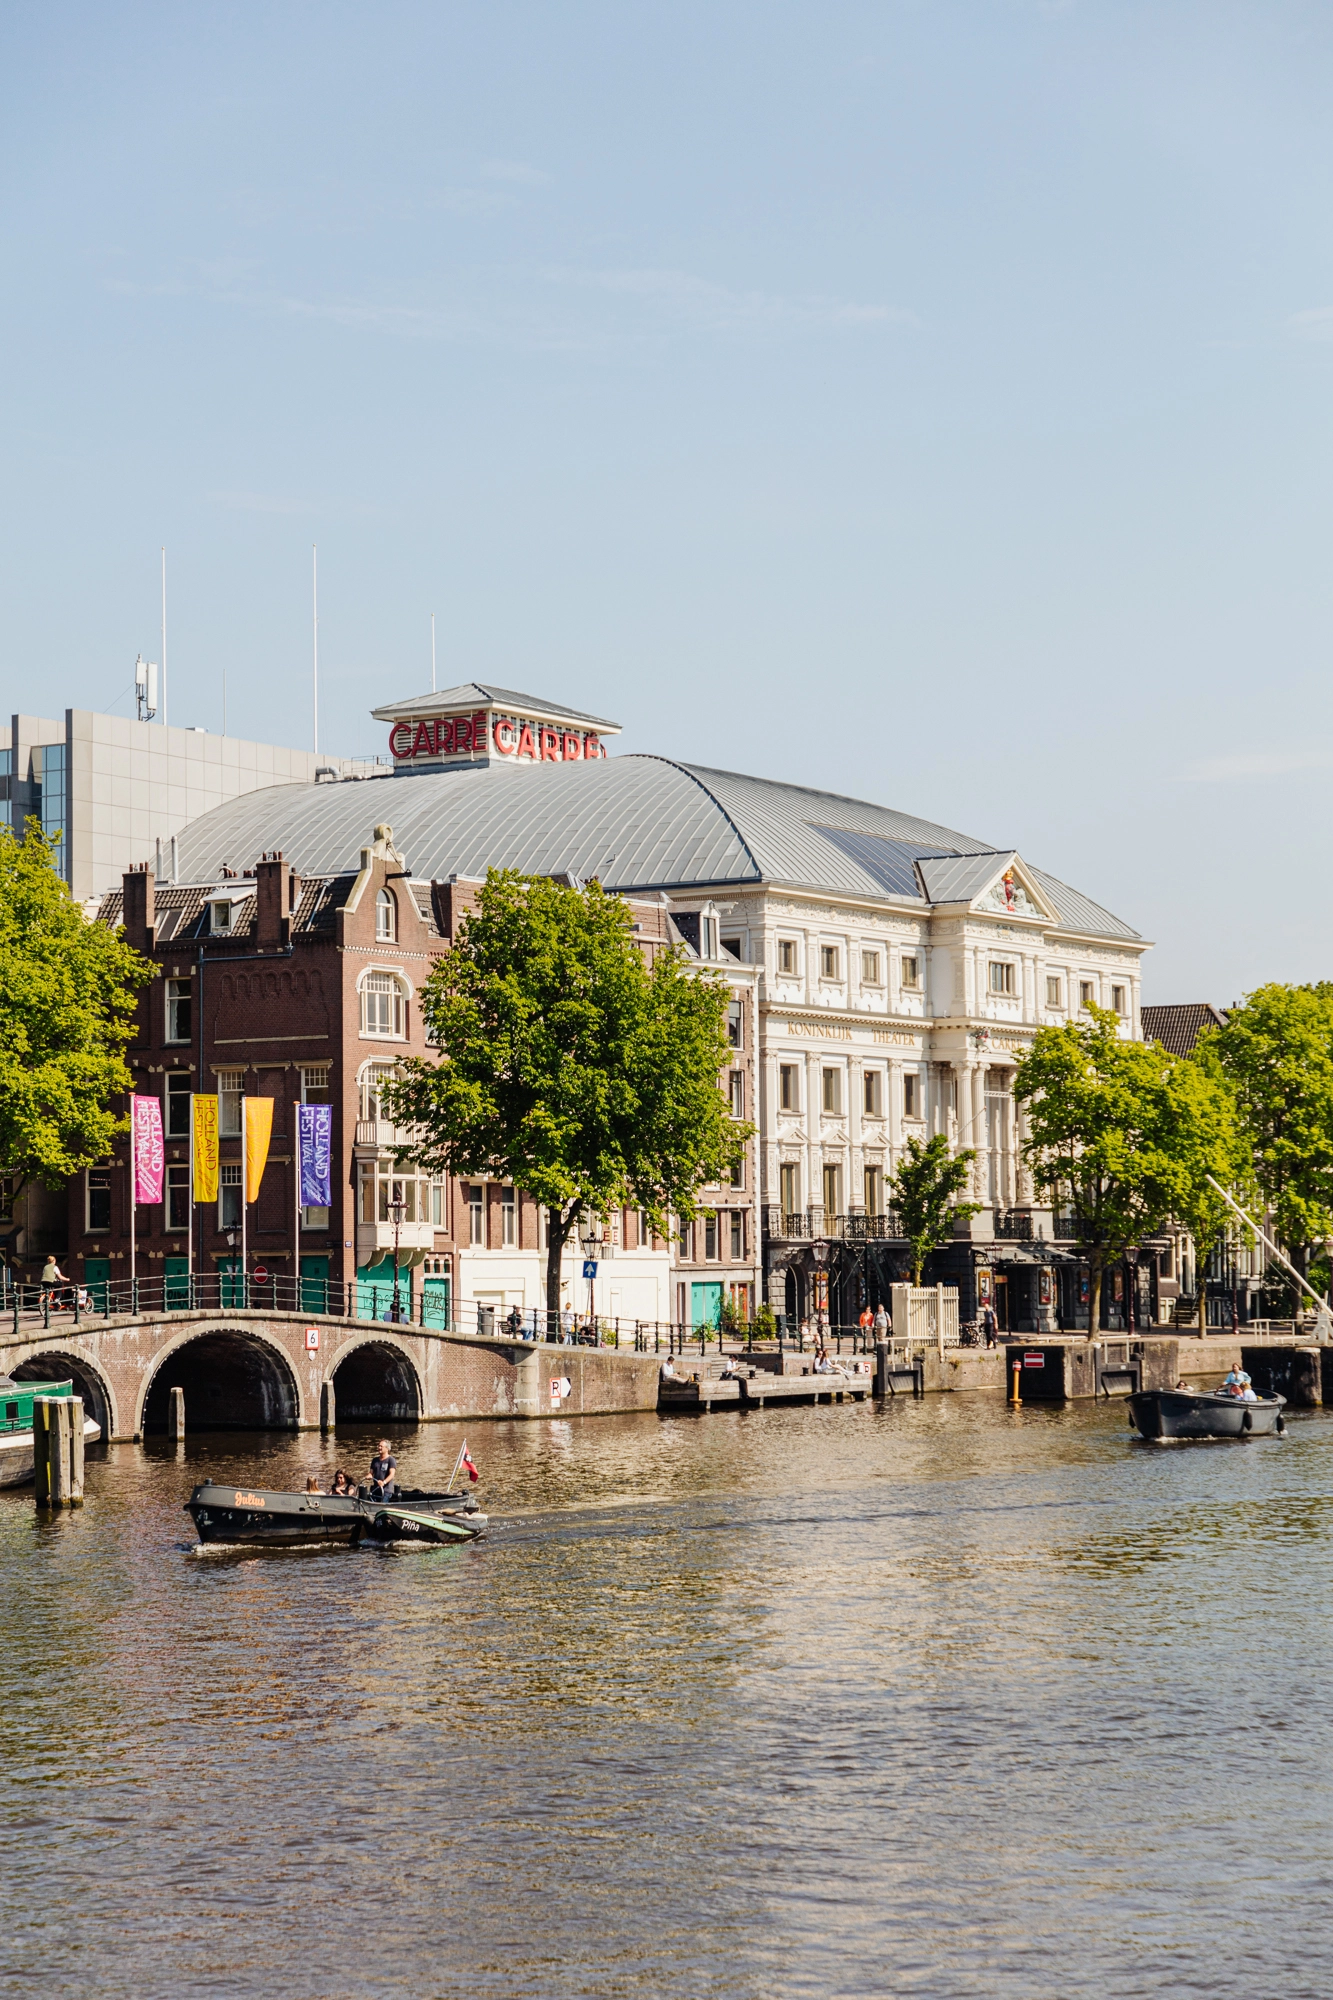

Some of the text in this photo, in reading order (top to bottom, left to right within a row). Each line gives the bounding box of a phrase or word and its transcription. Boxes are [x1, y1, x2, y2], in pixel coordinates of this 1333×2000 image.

[388, 710, 488, 758] CARRÉ
[787, 1020, 853, 1041] KONINKLIJK
[871, 1028, 915, 1046] THEATER
[137, 1101, 150, 1162] FESTIVAL
[149, 1101, 163, 1172] HOLLAND
[204, 1099, 216, 1171] HOLLAND
[302, 1107, 314, 1166] FESTIVAL
[315, 1107, 330, 1179] HOLLAND
[310, 1333, 316, 1344] 6
[234, 1491, 266, 1507] Julius
[401, 1519, 420, 1532] Piña
